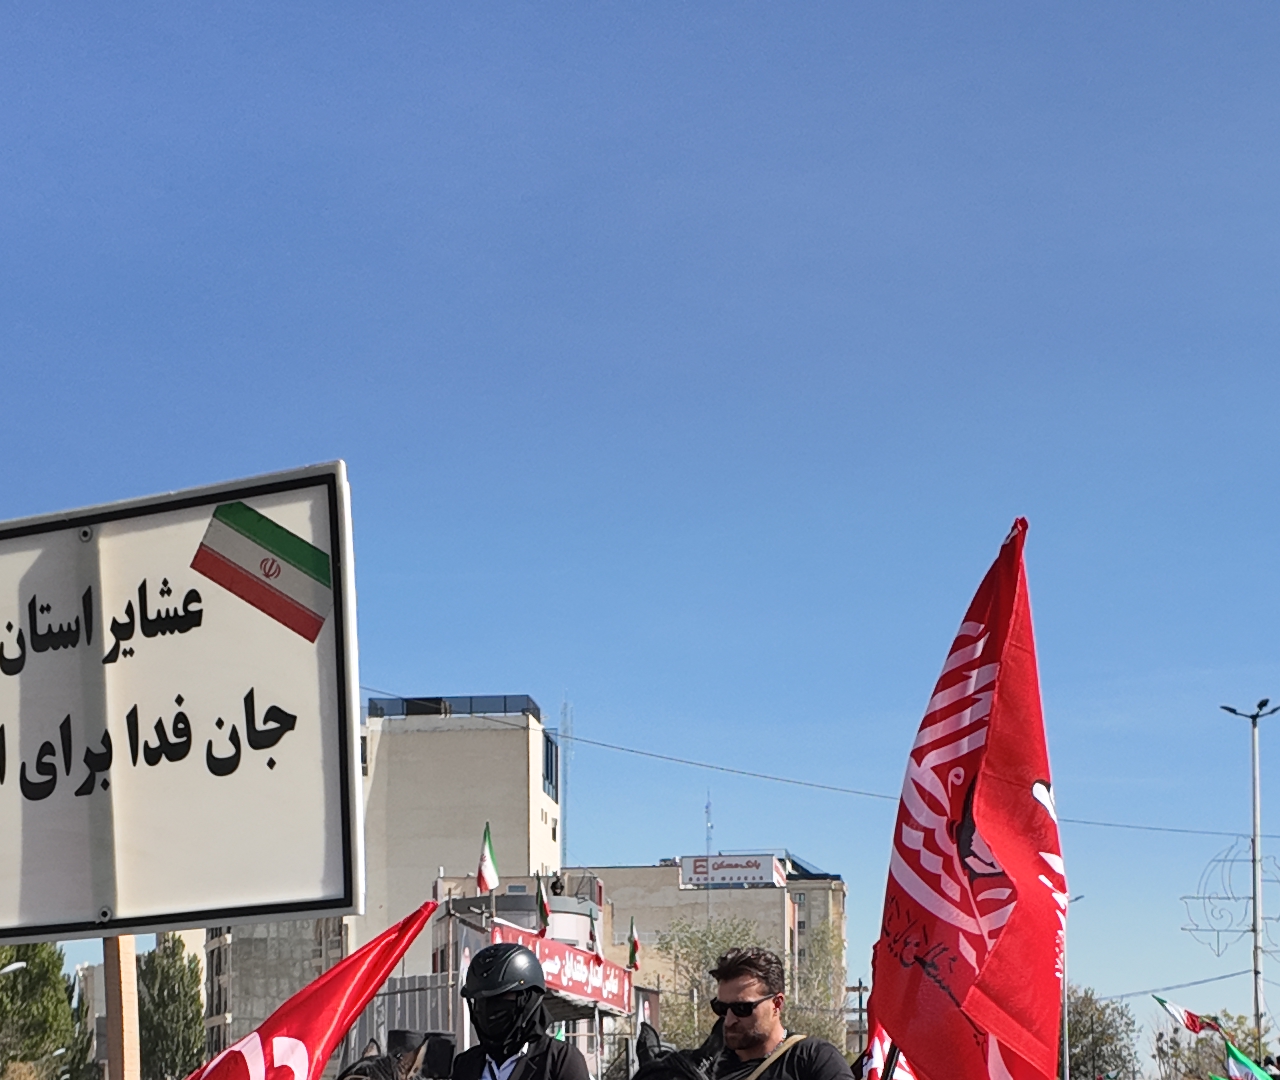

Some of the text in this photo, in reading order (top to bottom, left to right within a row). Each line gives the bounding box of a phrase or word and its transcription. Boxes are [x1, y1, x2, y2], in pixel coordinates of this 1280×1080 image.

[0, 586, 93, 675] استان
[102, 577, 204, 664] عشایر
[19, 715, 112, 801] برای
[126, 693, 193, 767] فدا
[205, 687, 297, 776] جان
